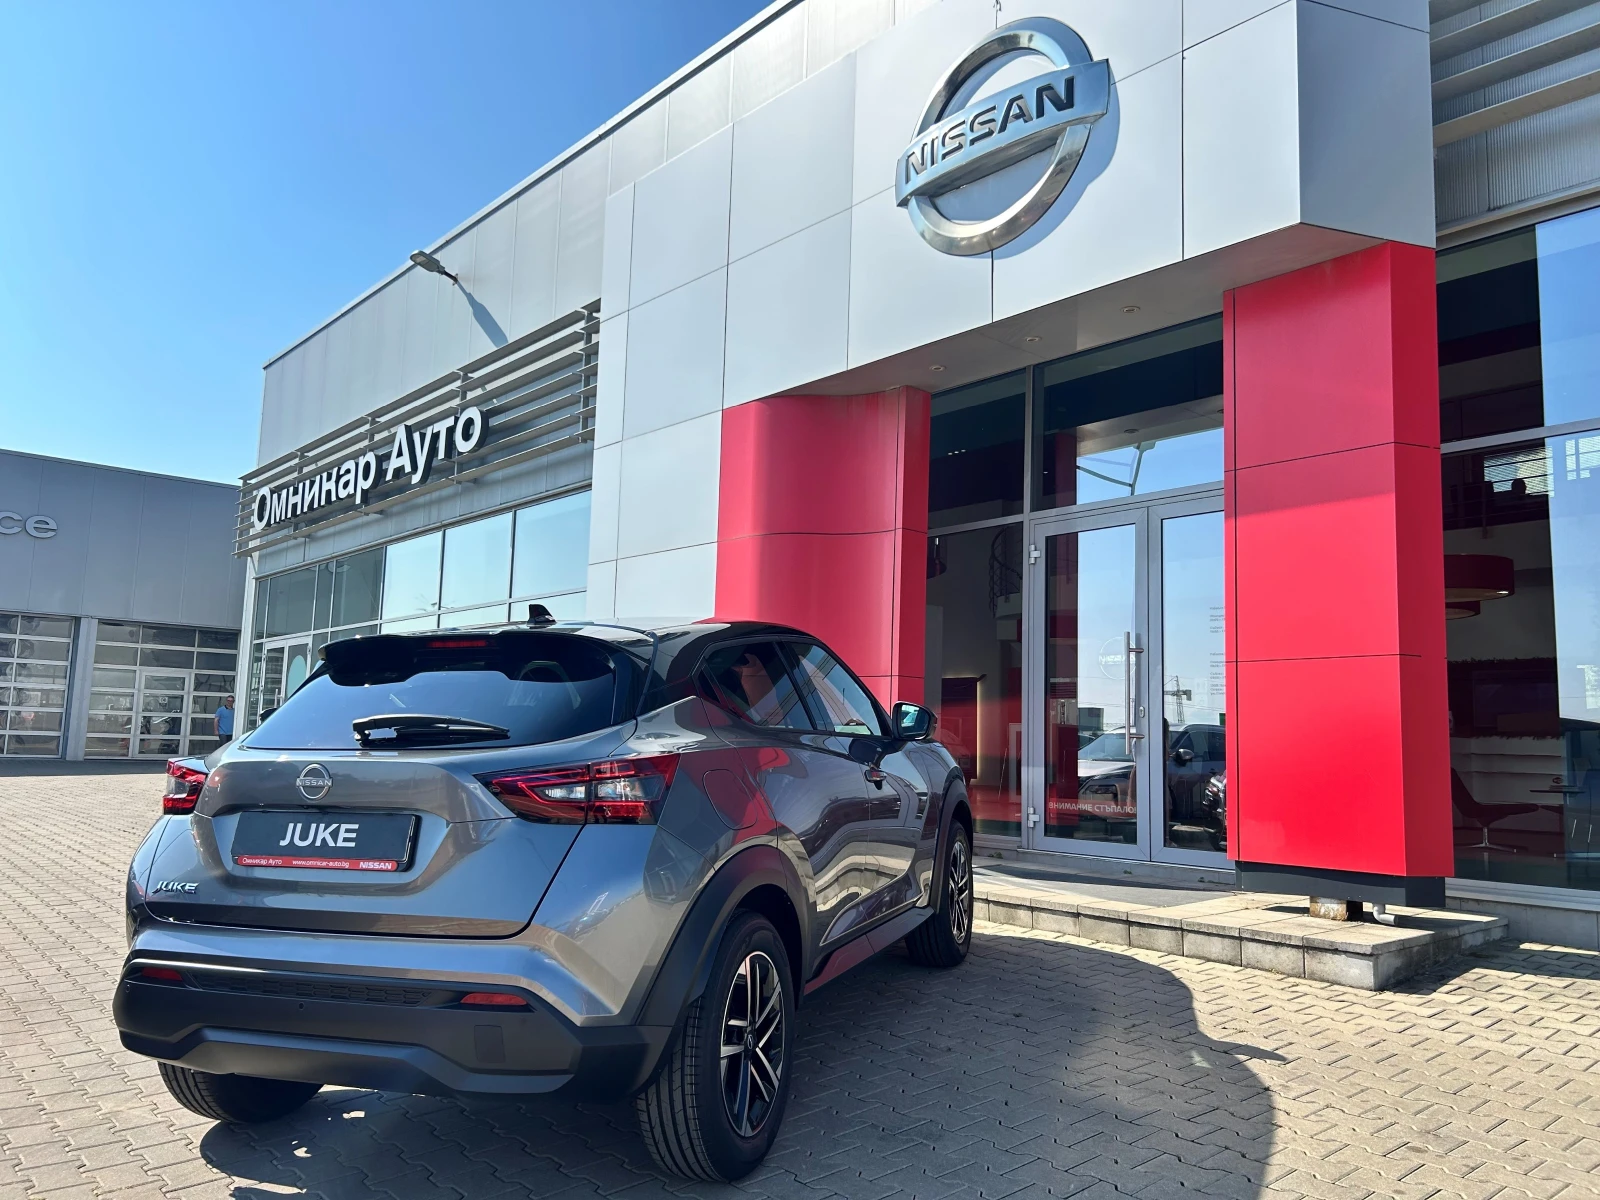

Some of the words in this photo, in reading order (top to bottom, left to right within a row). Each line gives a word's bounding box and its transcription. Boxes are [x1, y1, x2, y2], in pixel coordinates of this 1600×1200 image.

[905, 75, 1075, 185] NISSAN
[253, 451, 378, 531] Омникар
[385, 406, 483, 485] Ауто
[1048, 802, 1093, 811] ВНИМАНИЕ
[279, 823, 359, 847] JUKE
[242, 857, 267, 865] Омникар
[292, 860, 350, 868] www.omnicar-auto.bg
[359, 861, 392, 870] NISSAN
[152, 881, 199, 894] JUKE
